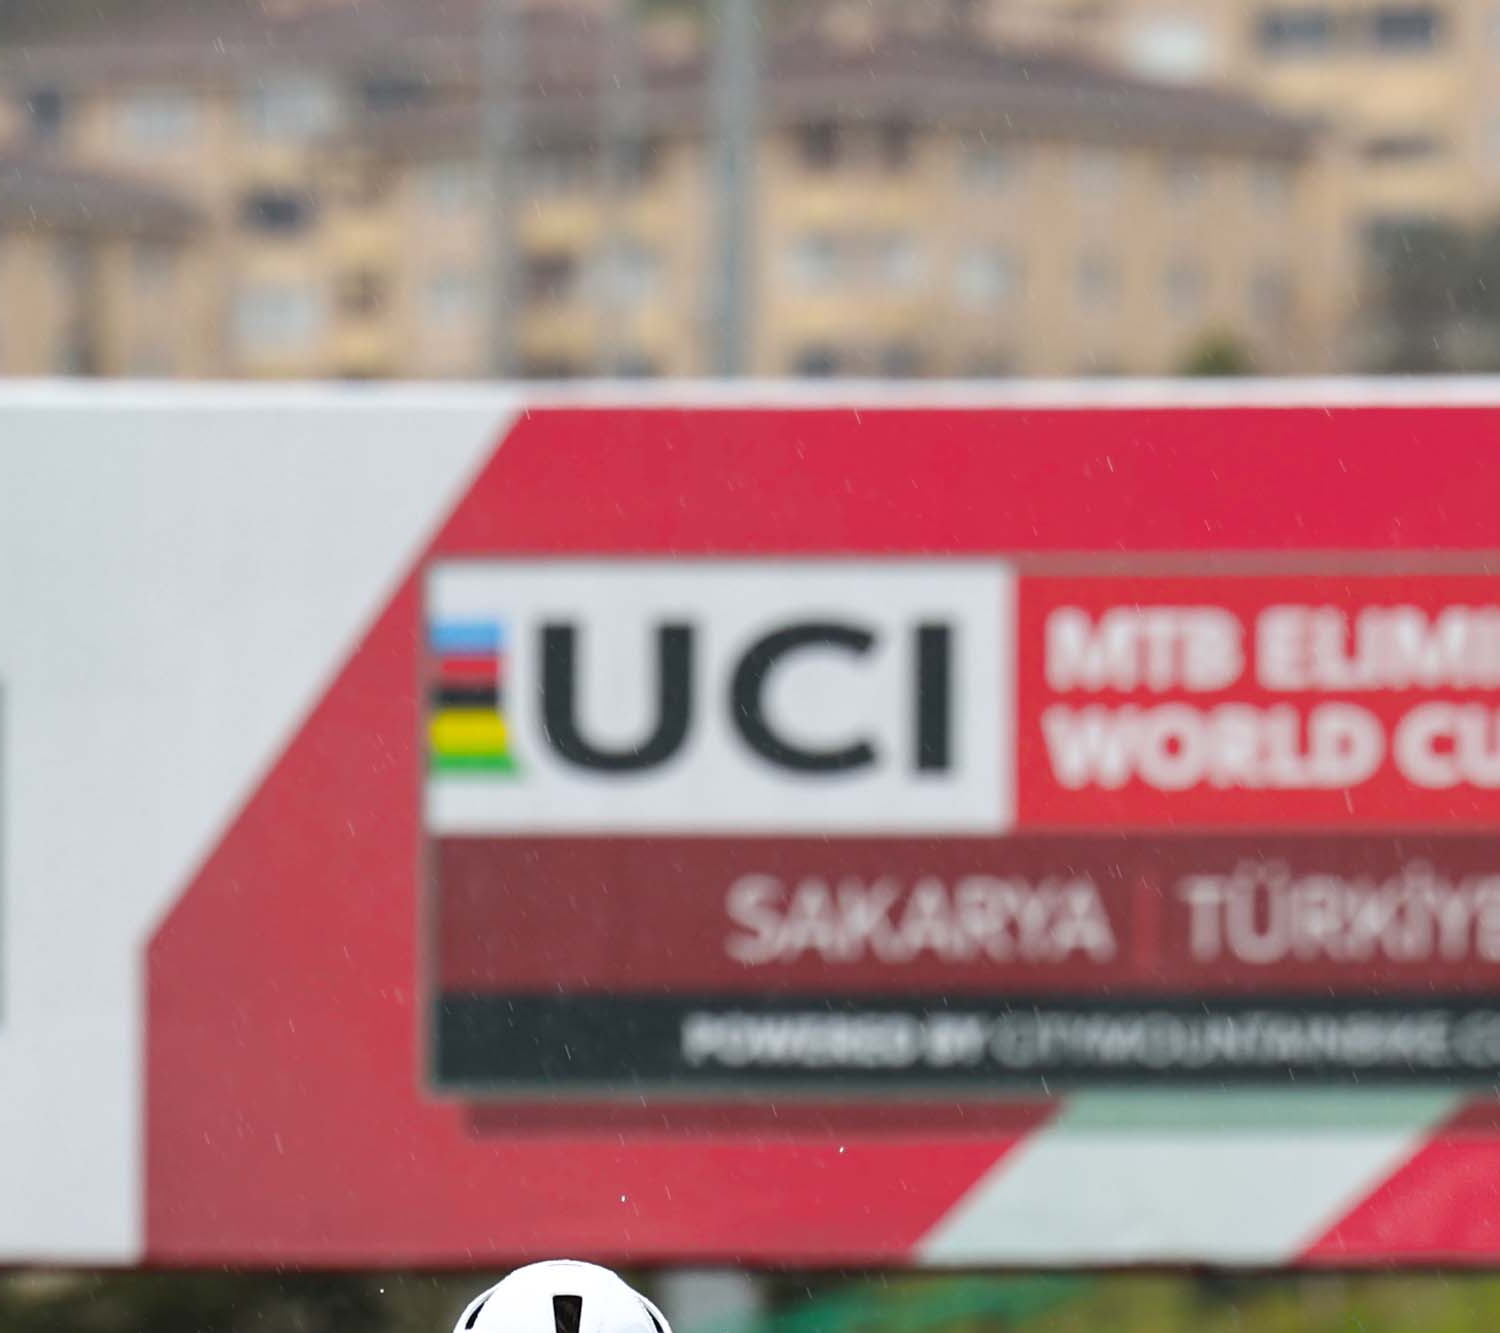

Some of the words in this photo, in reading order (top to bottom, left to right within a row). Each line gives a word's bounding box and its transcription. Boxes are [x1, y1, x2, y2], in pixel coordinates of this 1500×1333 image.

[1044, 607, 1244, 690] MTB
[536, 617, 955, 777] UCI
[1044, 704, 1383, 789] WORLD
[725, 874, 1114, 964] SAKARYA
[683, 1012, 916, 1068] POWERED
[923, 1012, 983, 1066] BY
